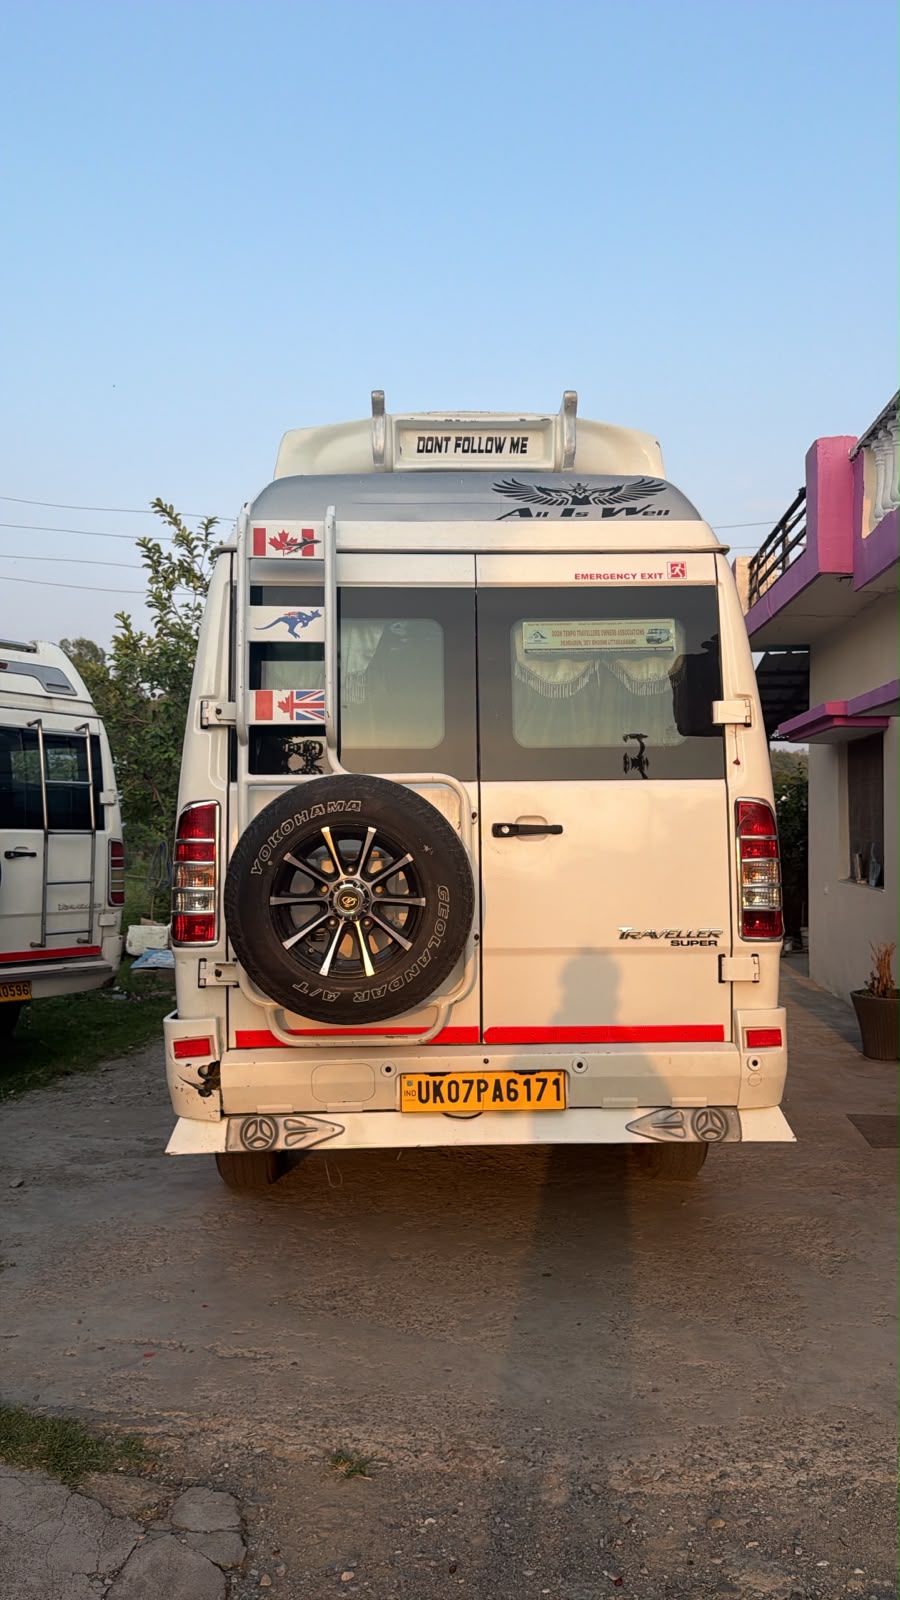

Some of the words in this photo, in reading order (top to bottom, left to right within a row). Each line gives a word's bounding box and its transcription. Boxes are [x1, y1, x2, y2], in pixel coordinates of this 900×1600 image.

[416, 436, 451, 454] DONT
[454, 436, 507, 454] FOLLOW
[509, 436, 529, 454] ME
[495, 507, 549, 521] All
[601, 503, 671, 518] Well
[574, 573, 637, 581] EMERGENCY
[640, 572, 664, 580] EXIT
[250, 800, 362, 875] YOKOHAMA
[353, 884, 450, 1003] GEOLANDAR
[670, 939, 718, 947] SUPER
[0, 983, 29, 998] 0596
[292, 981, 342, 1003] A/T
[403, 1089, 417, 1097] IND
[417, 1077, 562, 1104] UK07PA6171
